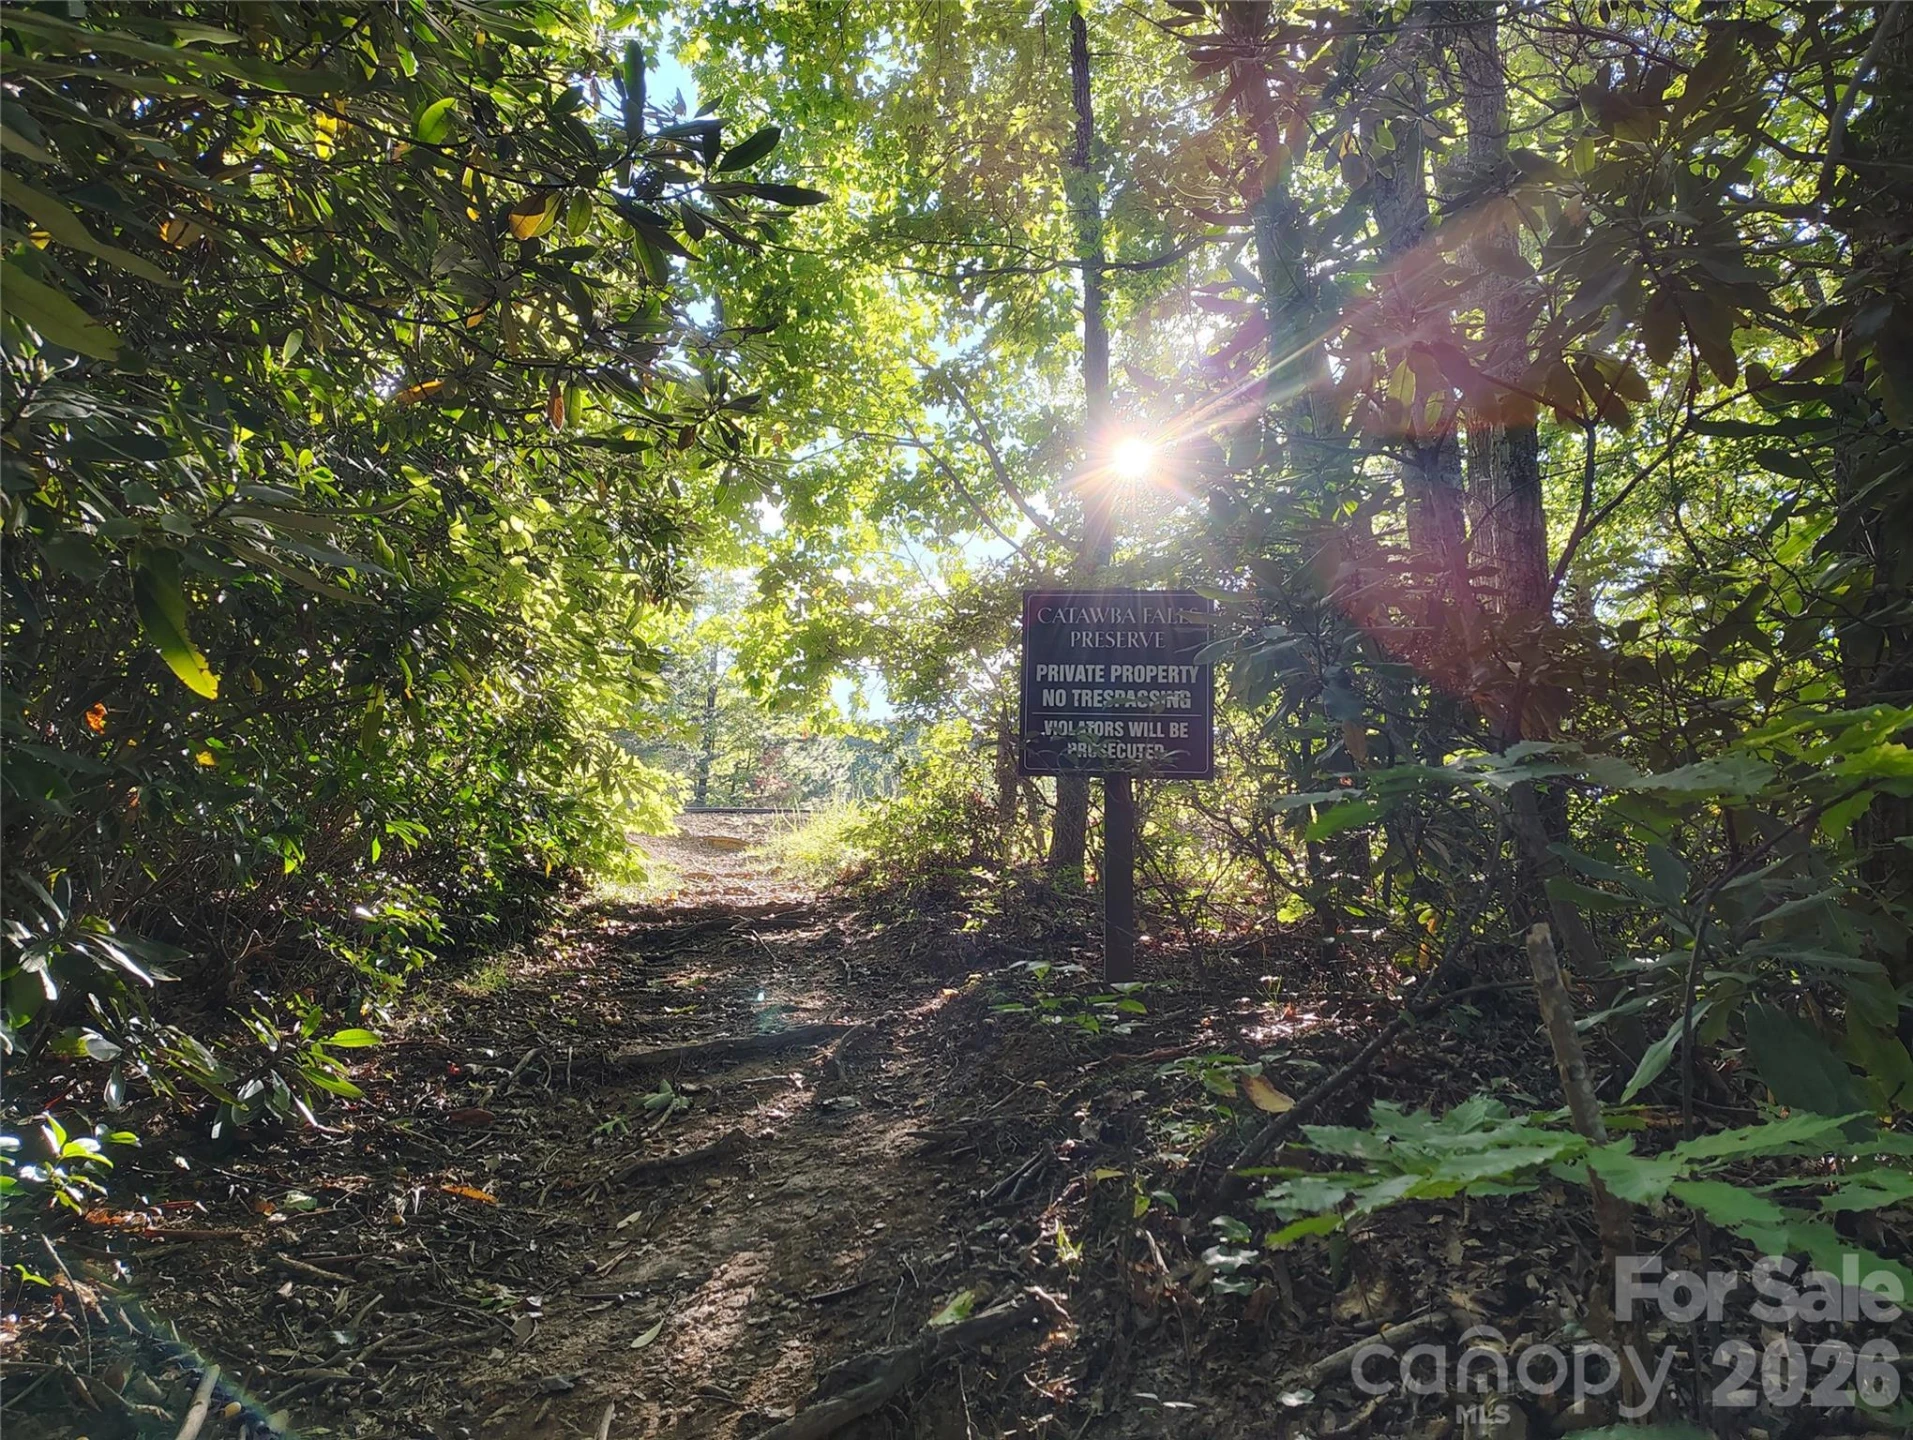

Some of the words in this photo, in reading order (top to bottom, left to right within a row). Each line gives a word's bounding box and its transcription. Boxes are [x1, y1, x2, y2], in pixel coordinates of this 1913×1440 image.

[1037, 607, 1136, 625] CATAWBA
[1143, 607, 1198, 625] FALL
[1070, 631, 1166, 649] PRESERVE
[1036, 664, 1104, 683] PRIVATE
[1110, 665, 1199, 684] PROPERTY
[1042, 689, 1066, 707] NO
[1044, 720, 1124, 737] VIOLATORS
[1128, 722, 1165, 738] WILL
[1169, 722, 1188, 738] BE
